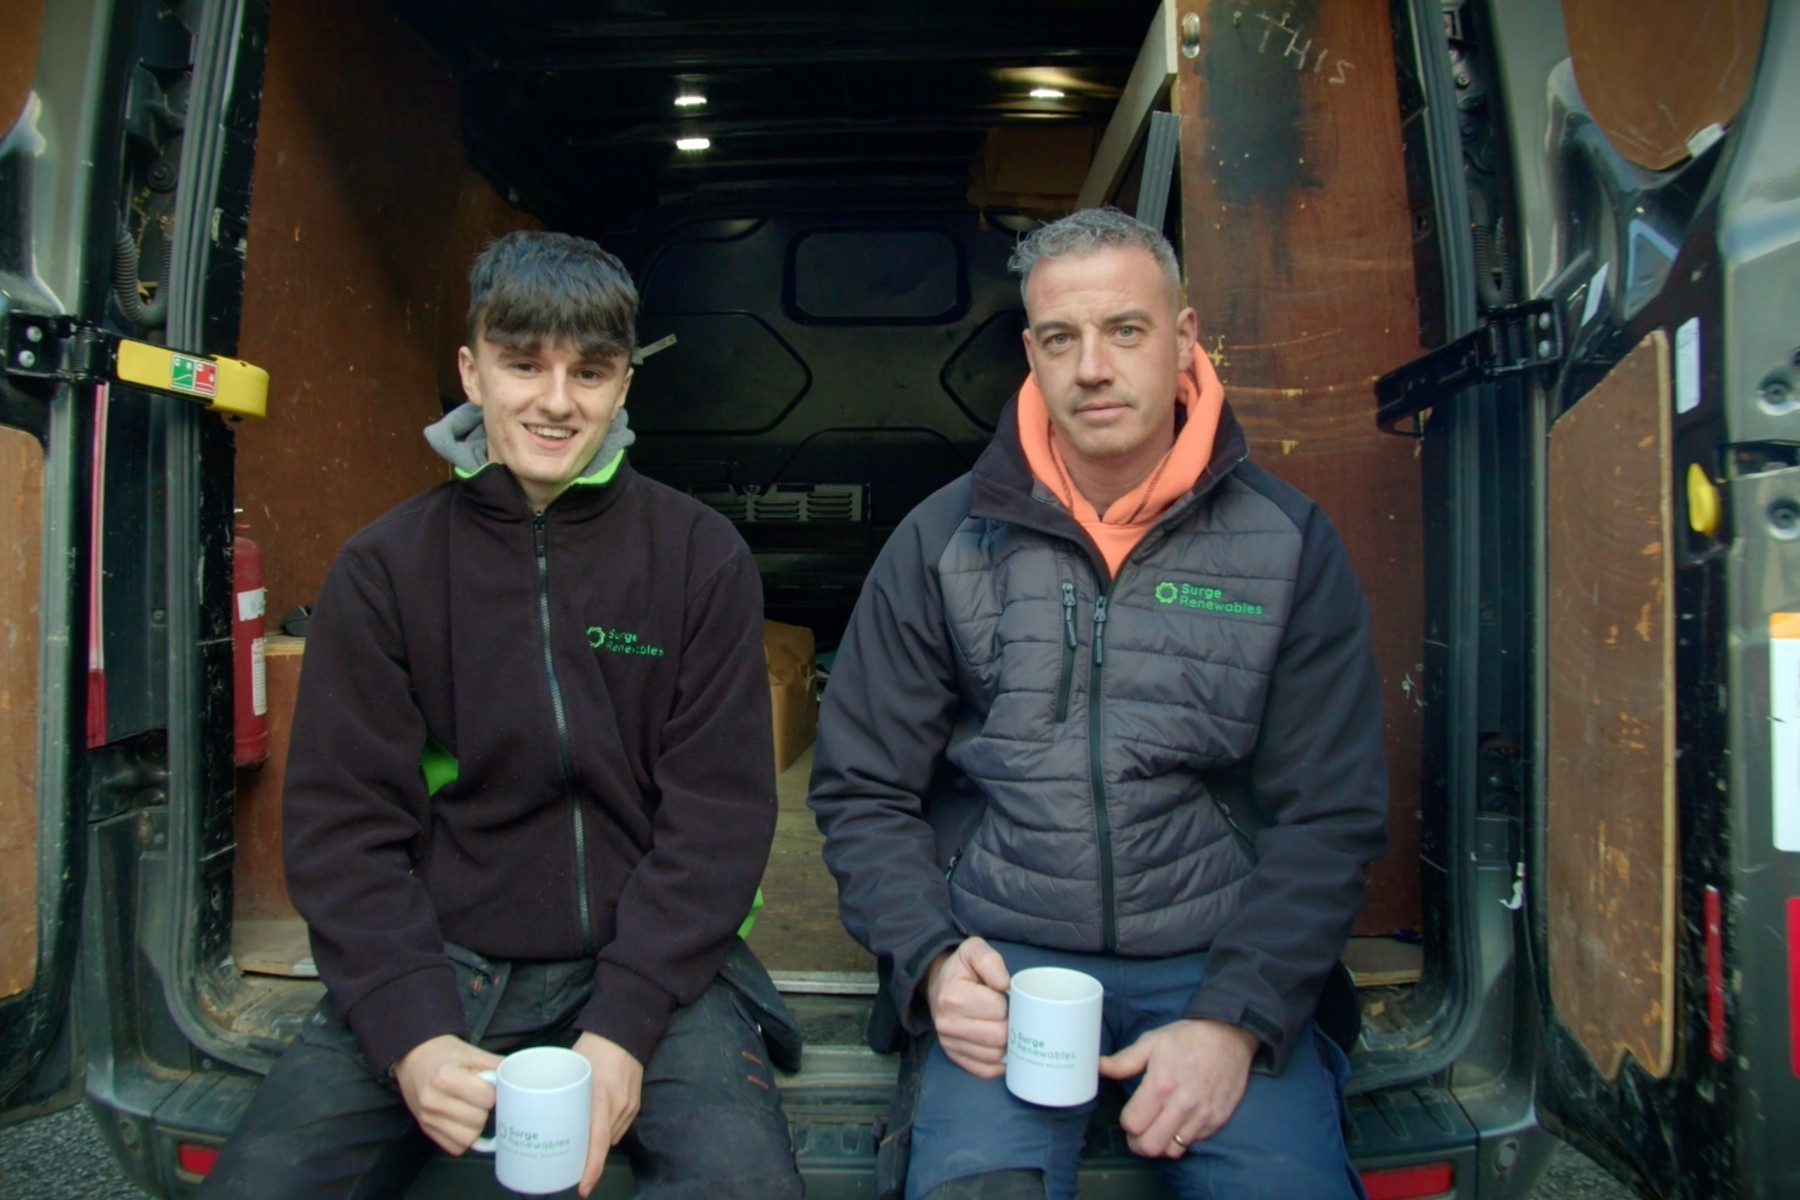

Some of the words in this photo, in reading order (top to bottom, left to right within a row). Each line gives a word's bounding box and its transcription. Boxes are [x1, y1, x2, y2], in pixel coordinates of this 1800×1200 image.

[1255, 10, 1356, 83] THIS
[1181, 583, 1222, 600] Surge
[1180, 595, 1263, 615] Renewables
[608, 628, 639, 643] Surge
[1018, 1032, 1045, 1048] Surge
[1017, 1041, 1076, 1060] Renewables
[509, 1126, 538, 1140] Surge
[508, 1136, 570, 1149] Renewables
